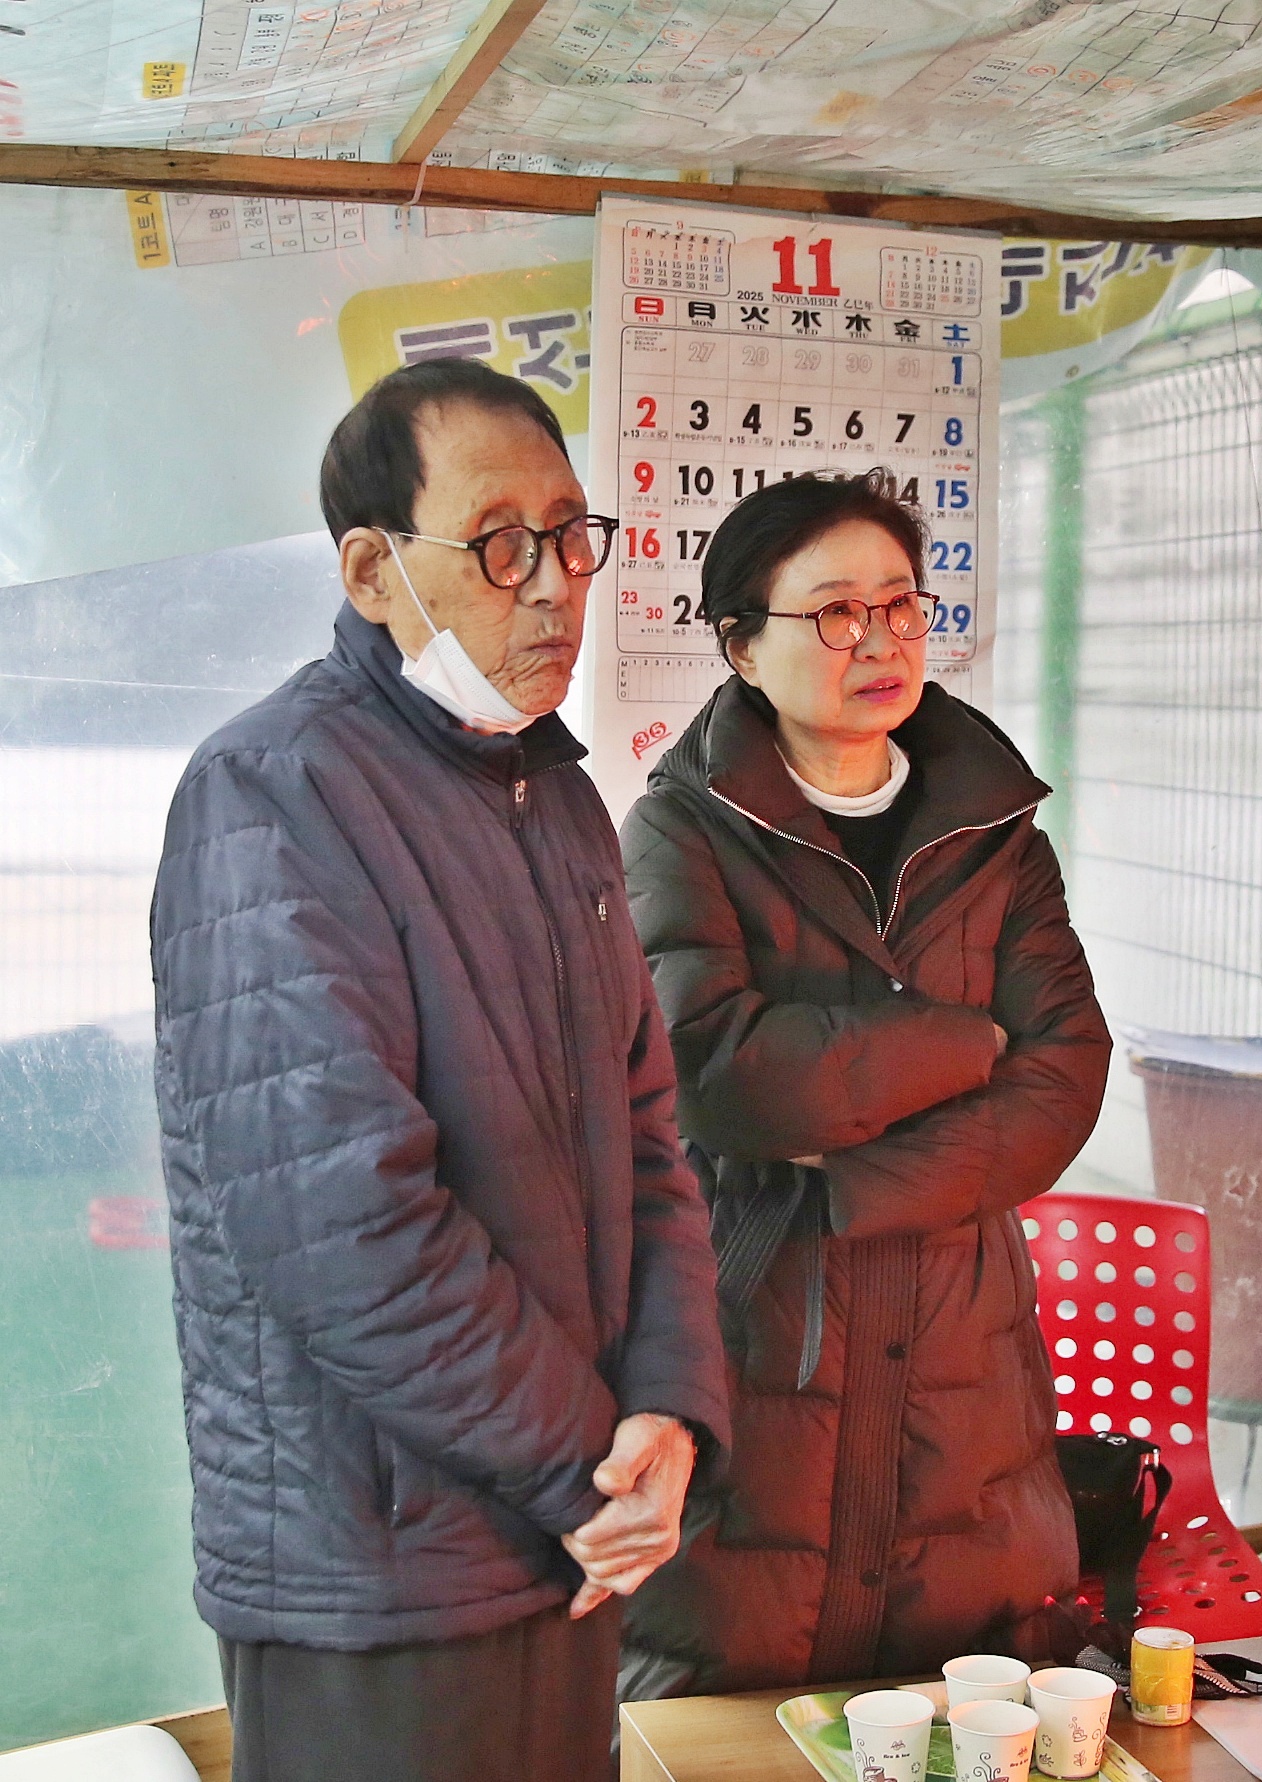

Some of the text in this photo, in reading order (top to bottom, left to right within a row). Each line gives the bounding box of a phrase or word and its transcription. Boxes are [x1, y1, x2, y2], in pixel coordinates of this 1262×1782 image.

[137, 212, 161, 262] 1코트
[644, 258, 653, 266] 13
[658, 260, 667, 268] 14
[673, 261, 681, 269] 15
[658, 269, 667, 277] 21
[772, 236, 841, 297] 11
[635, 296, 970, 341] 日 月 火 水 木 金 土
[737, 291, 838, 307] 2025 NOVEMBER
[691, 319, 713, 328] MON
[796, 328, 818, 336] WED
[688, 342, 716, 362] 27
[742, 345, 769, 367] 28
[794, 349, 822, 371] 29
[847, 352, 872, 373] 30
[952, 356, 962, 385] 1
[636, 396, 963, 446] 2 3 4 5 6 7 8
[634, 461, 655, 492] 9
[678, 465, 714, 495] 10
[733, 468, 765, 498] 11
[935, 479, 970, 509] 15
[625, 527, 972, 570] 16 17 22
[621, 591, 639, 604] 23
[646, 607, 663, 619] 30
[673, 594, 971, 633] 24 29
